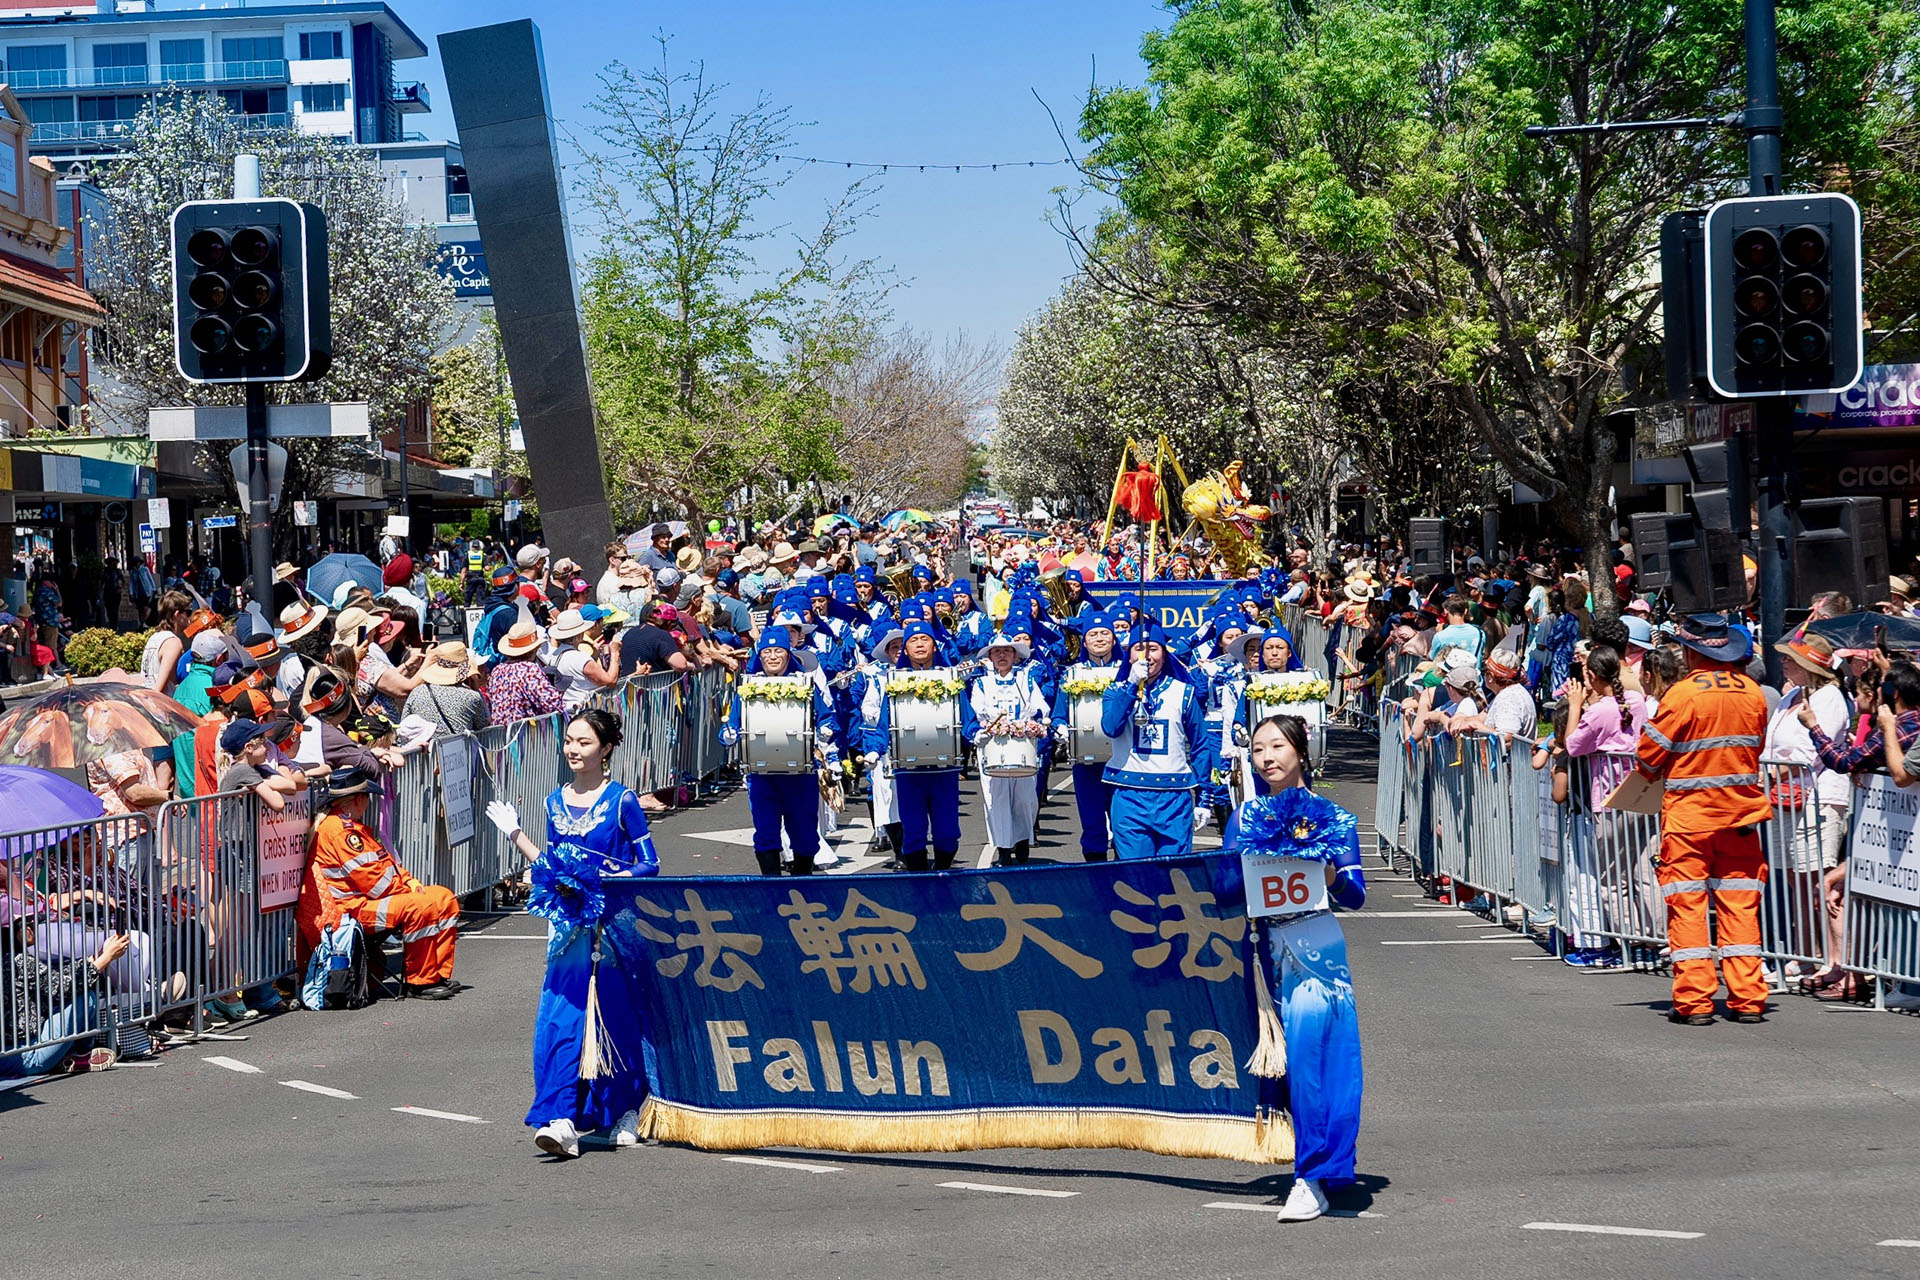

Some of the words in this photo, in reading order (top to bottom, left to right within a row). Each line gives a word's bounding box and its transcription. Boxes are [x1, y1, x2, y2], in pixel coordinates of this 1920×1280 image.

[15, 509, 42, 520] ANZ
[142, 530, 152, 538] PAY
[1693, 670, 1746, 689] SES
[1861, 786, 1918, 817] PEDESTRIANS
[263, 836, 287, 860] CROSS
[1861, 822, 1887, 848] CROSS
[1891, 827, 1914, 854] HERE
[1251, 858, 1276, 868] GRAND
[1853, 857, 1876, 882] WHEN
[1878, 862, 1919, 892] DIRECTED
[261, 871, 280, 895] WHEN
[1261, 871, 1309, 908] B6
[635, 867, 1248, 994] 法輪大法
[706, 1020, 951, 1097] Falun
[1017, 1009, 1241, 1090] Dafa
